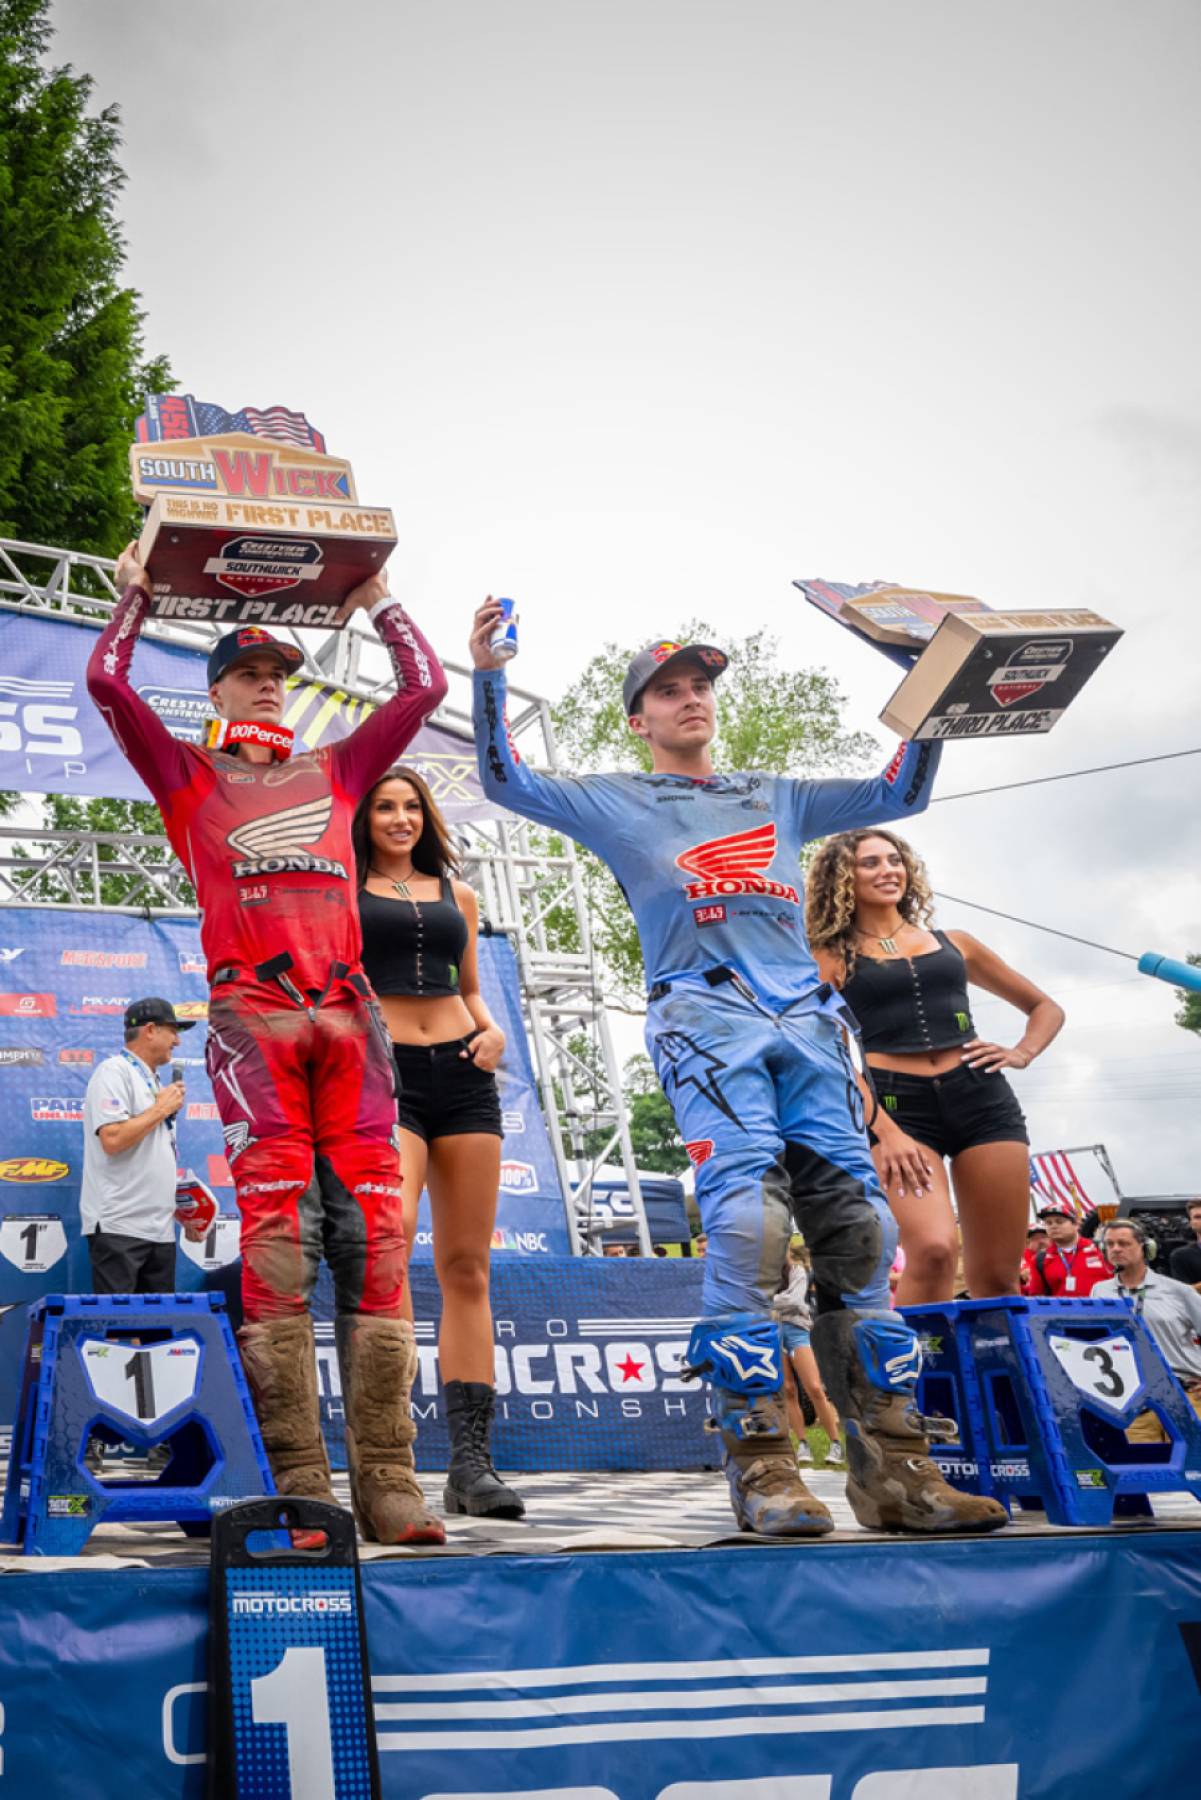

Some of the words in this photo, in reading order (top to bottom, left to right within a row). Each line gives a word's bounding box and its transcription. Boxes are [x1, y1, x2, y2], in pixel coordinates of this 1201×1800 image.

[139, 458, 217, 482] SOUTH
[225, 503, 299, 527] FIRST
[306, 510, 392, 533] PLACE
[934, 715, 989, 737] THIRD
[984, 710, 1050, 732] PLACE
[232, 856, 350, 879] HONDA
[684, 879, 800, 904] HONDA
[515, 1232, 548, 1252] NBC
[125, 1351, 156, 1419] 1
[1083, 1346, 1125, 1398] 3
[233, 1597, 352, 1614] MOTOCROSS
[251, 1647, 336, 1800] 1
